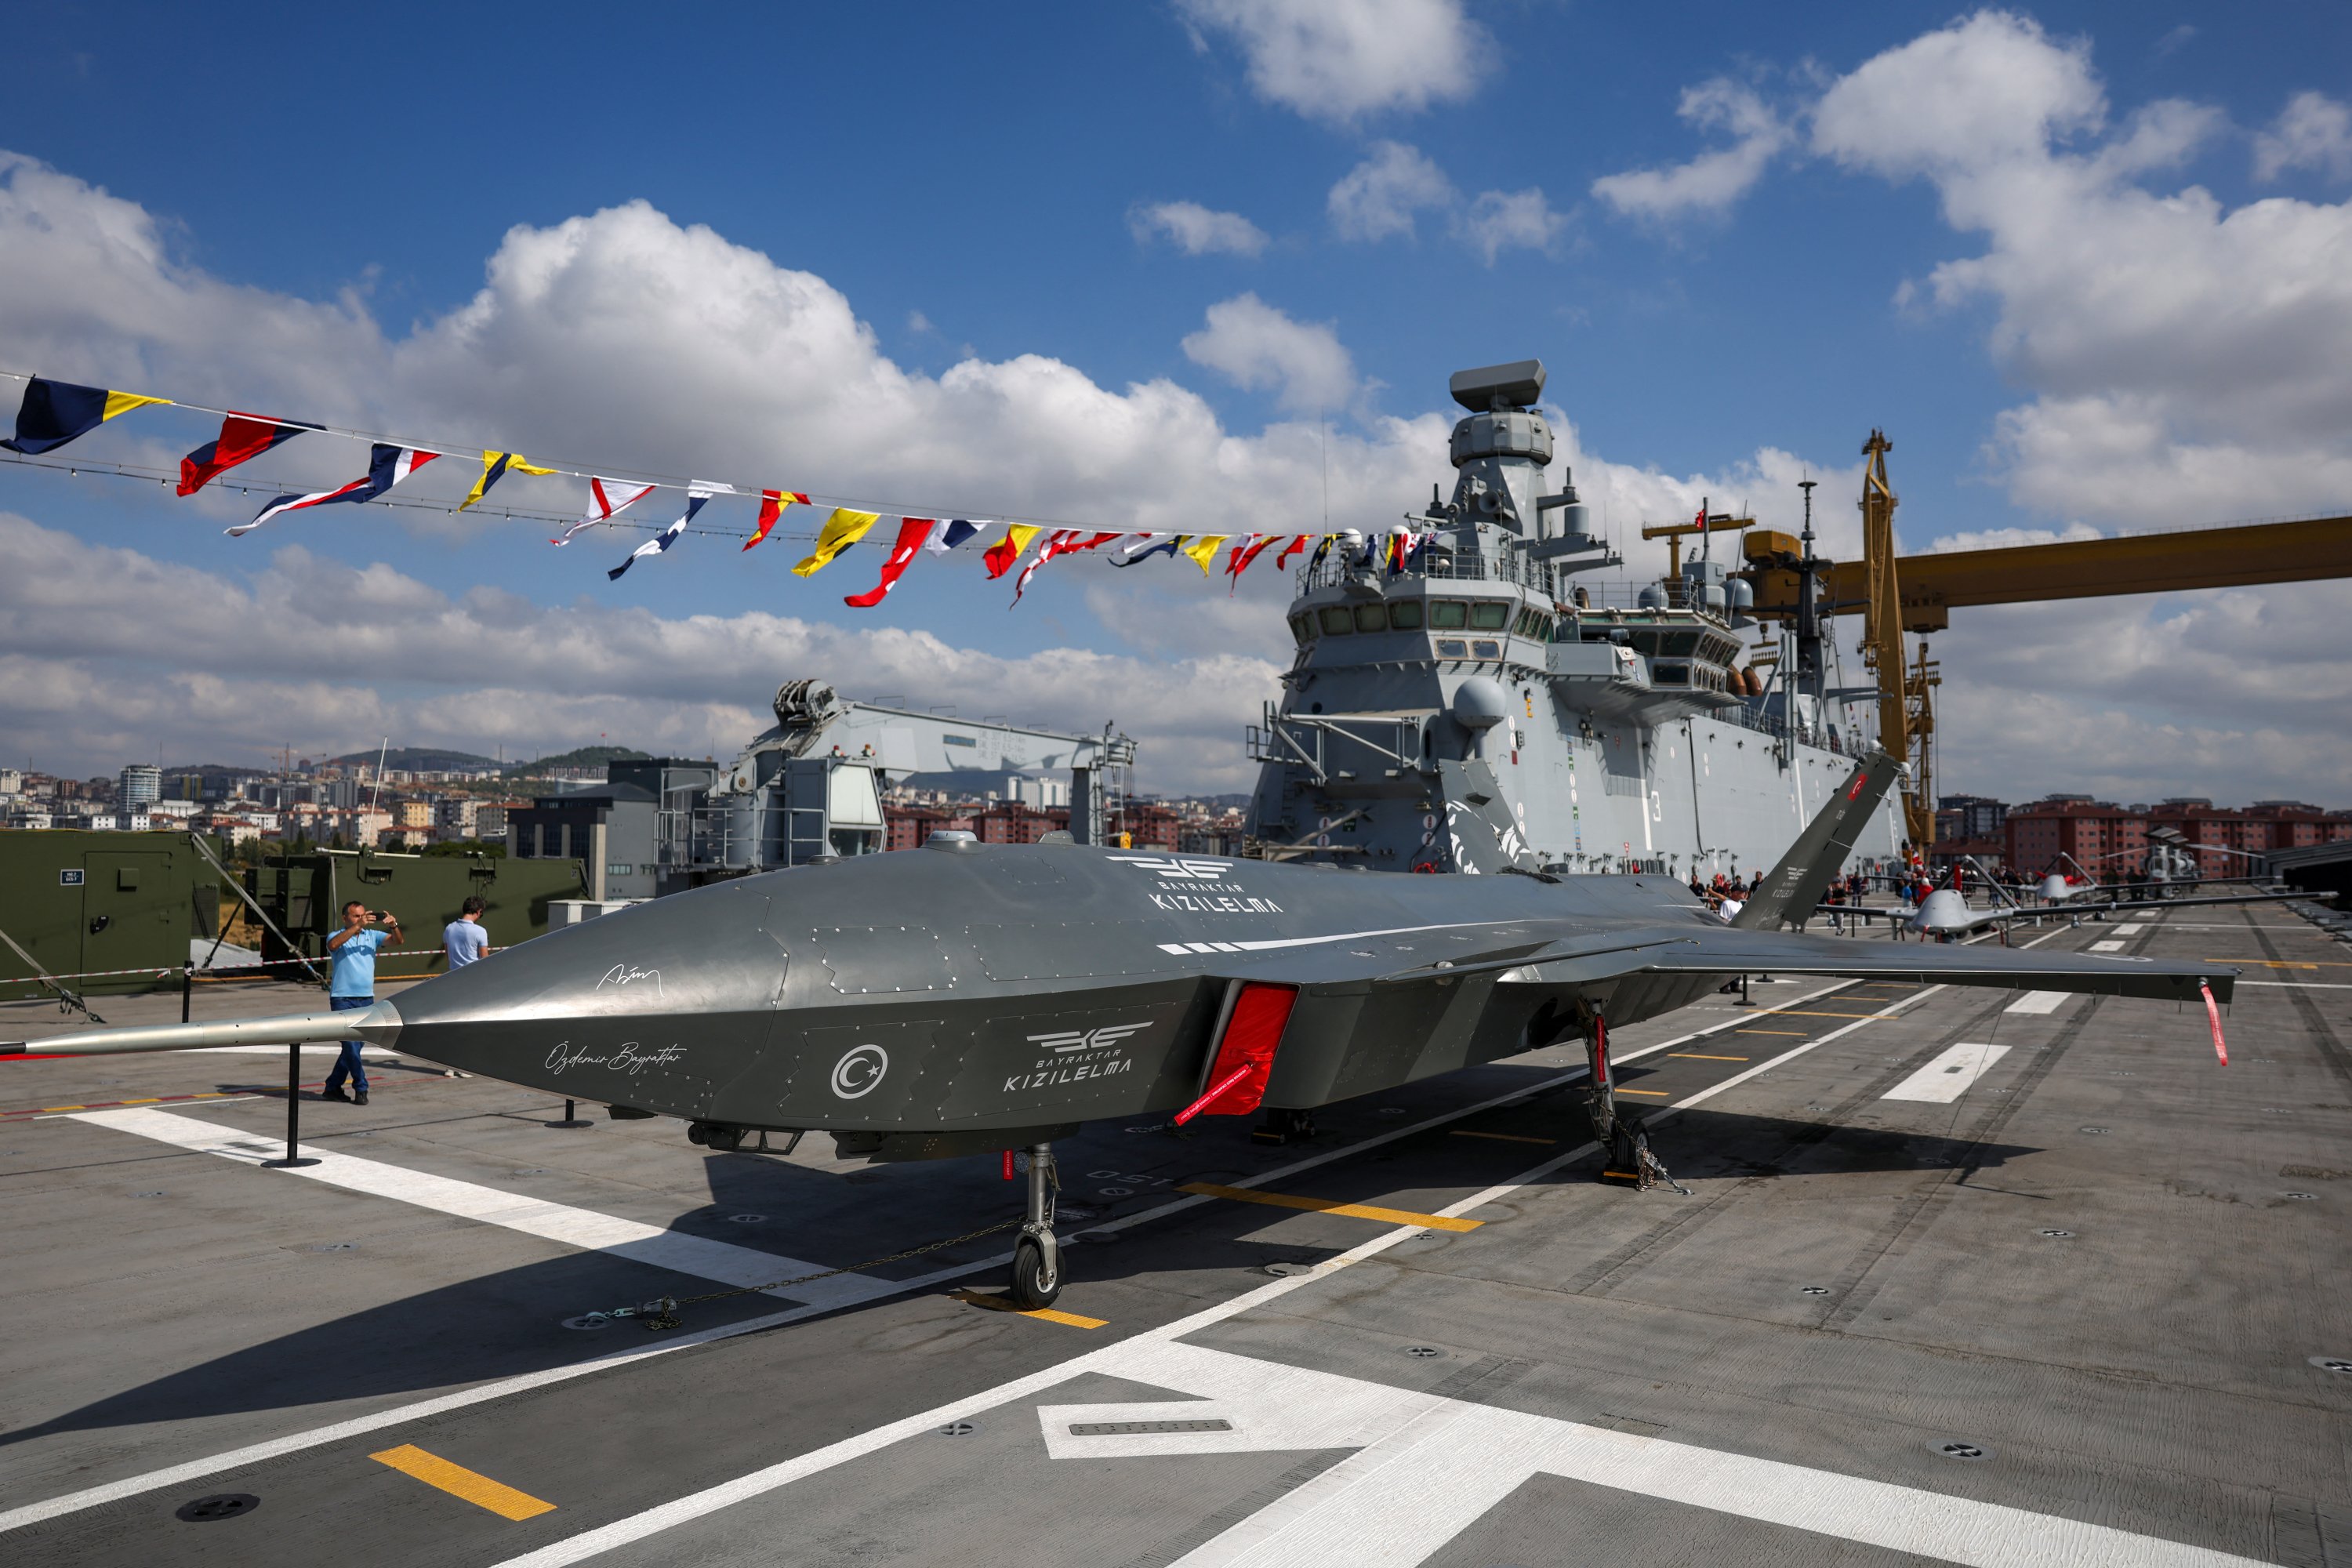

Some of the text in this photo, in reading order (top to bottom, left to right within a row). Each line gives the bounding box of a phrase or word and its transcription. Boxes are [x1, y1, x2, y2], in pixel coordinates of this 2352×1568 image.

[1651, 790, 1661, 822] 3
[1157, 881, 1245, 893] BAYRAKTAR
[1148, 894, 1284, 913] KIZILELMA
[545, 1040, 688, 1075] Özdemir Bayraktar
[1036, 1049, 1121, 1068] BAYRAKTAR
[1003, 1058, 1131, 1092] KIZILELMA
